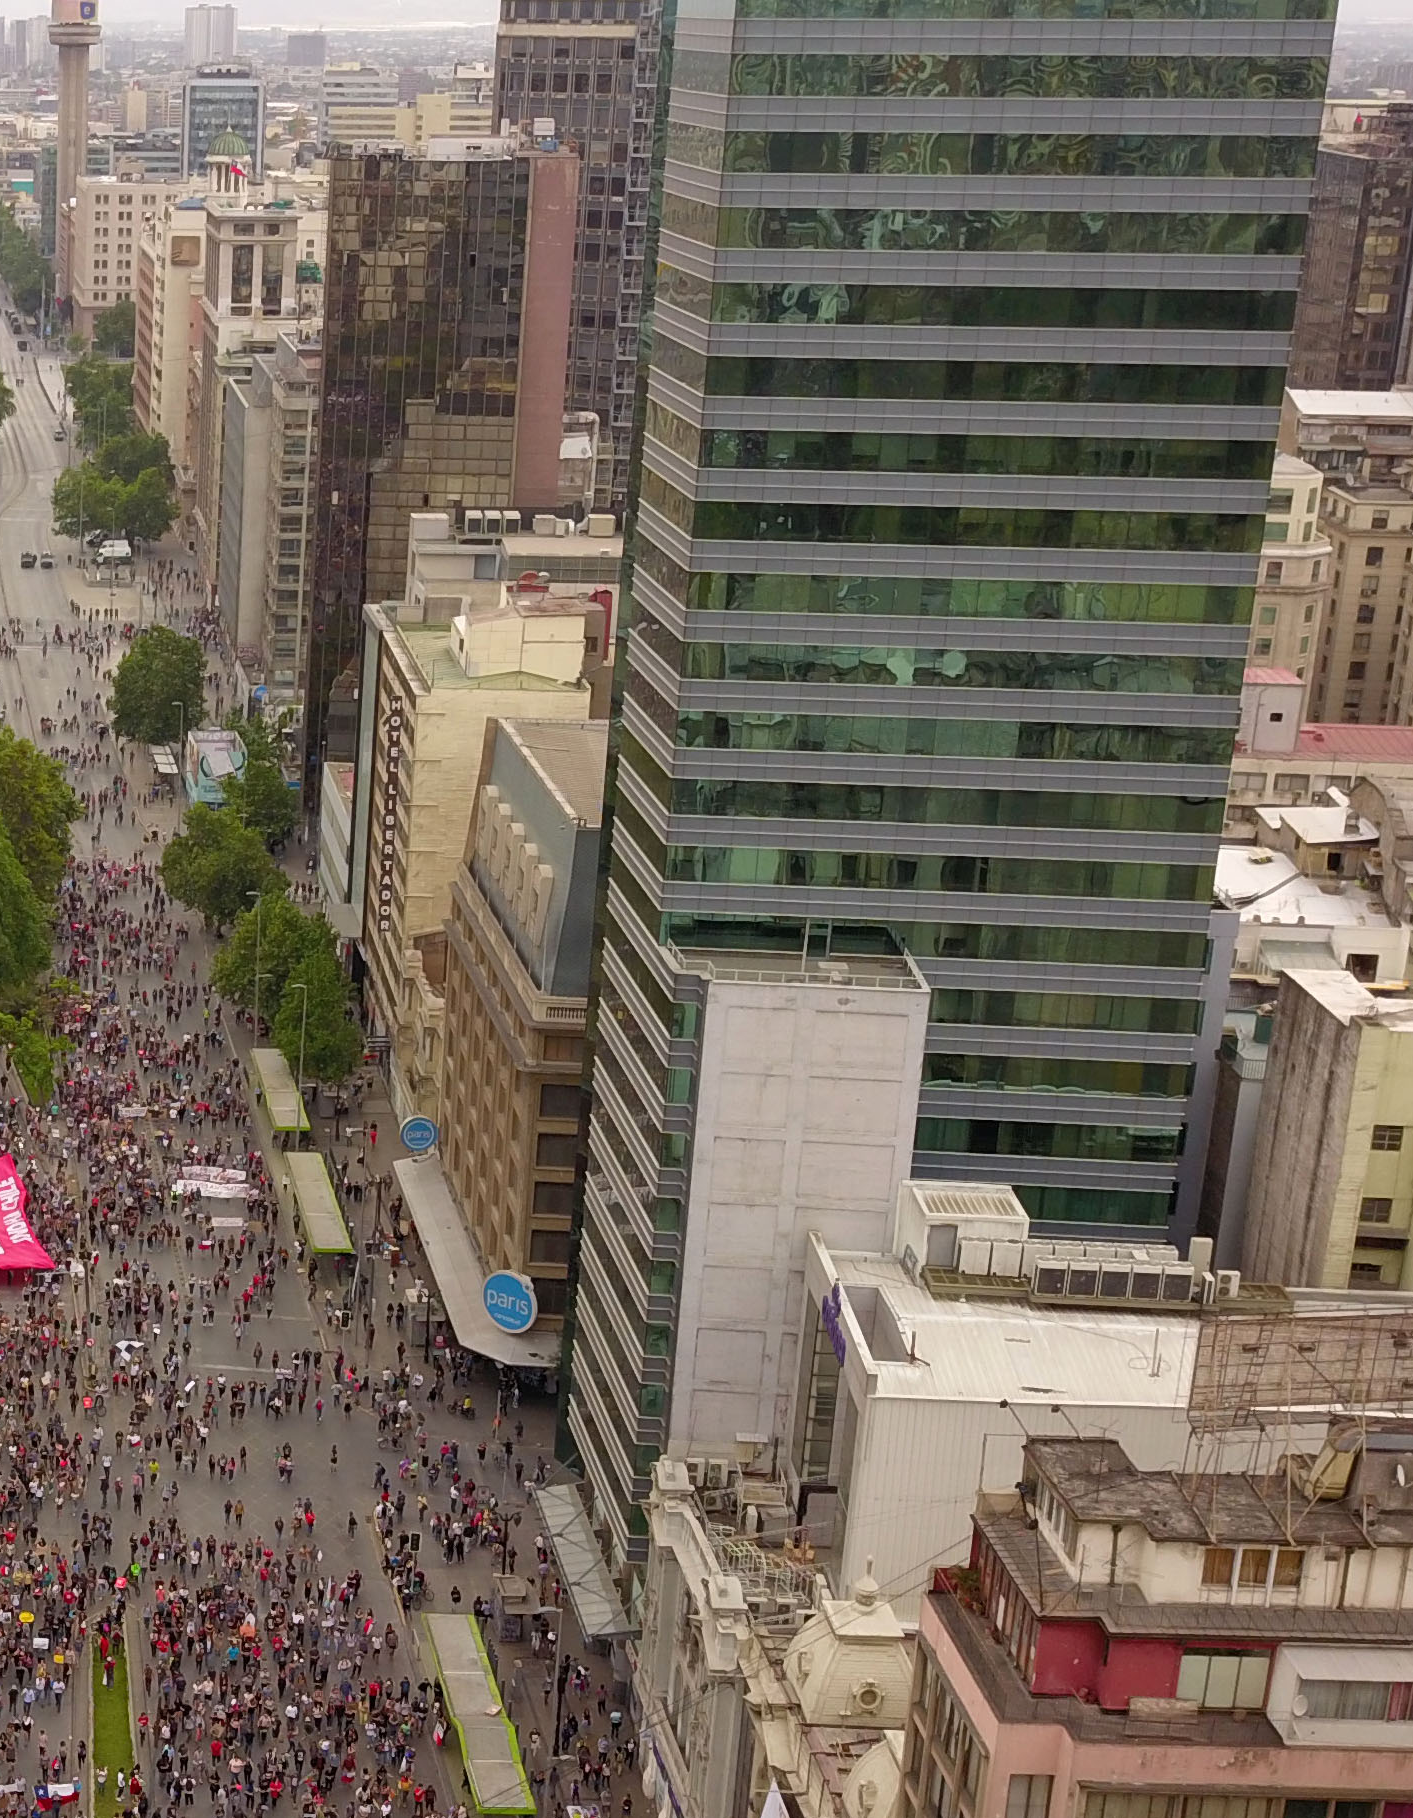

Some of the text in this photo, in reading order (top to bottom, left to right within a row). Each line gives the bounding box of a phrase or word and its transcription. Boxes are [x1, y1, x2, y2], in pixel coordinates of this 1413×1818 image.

[380, 700, 402, 931] HOTEL LIBERTADOR
[407, 1130, 431, 1140] paris
[486, 1288, 529, 1316] paris
